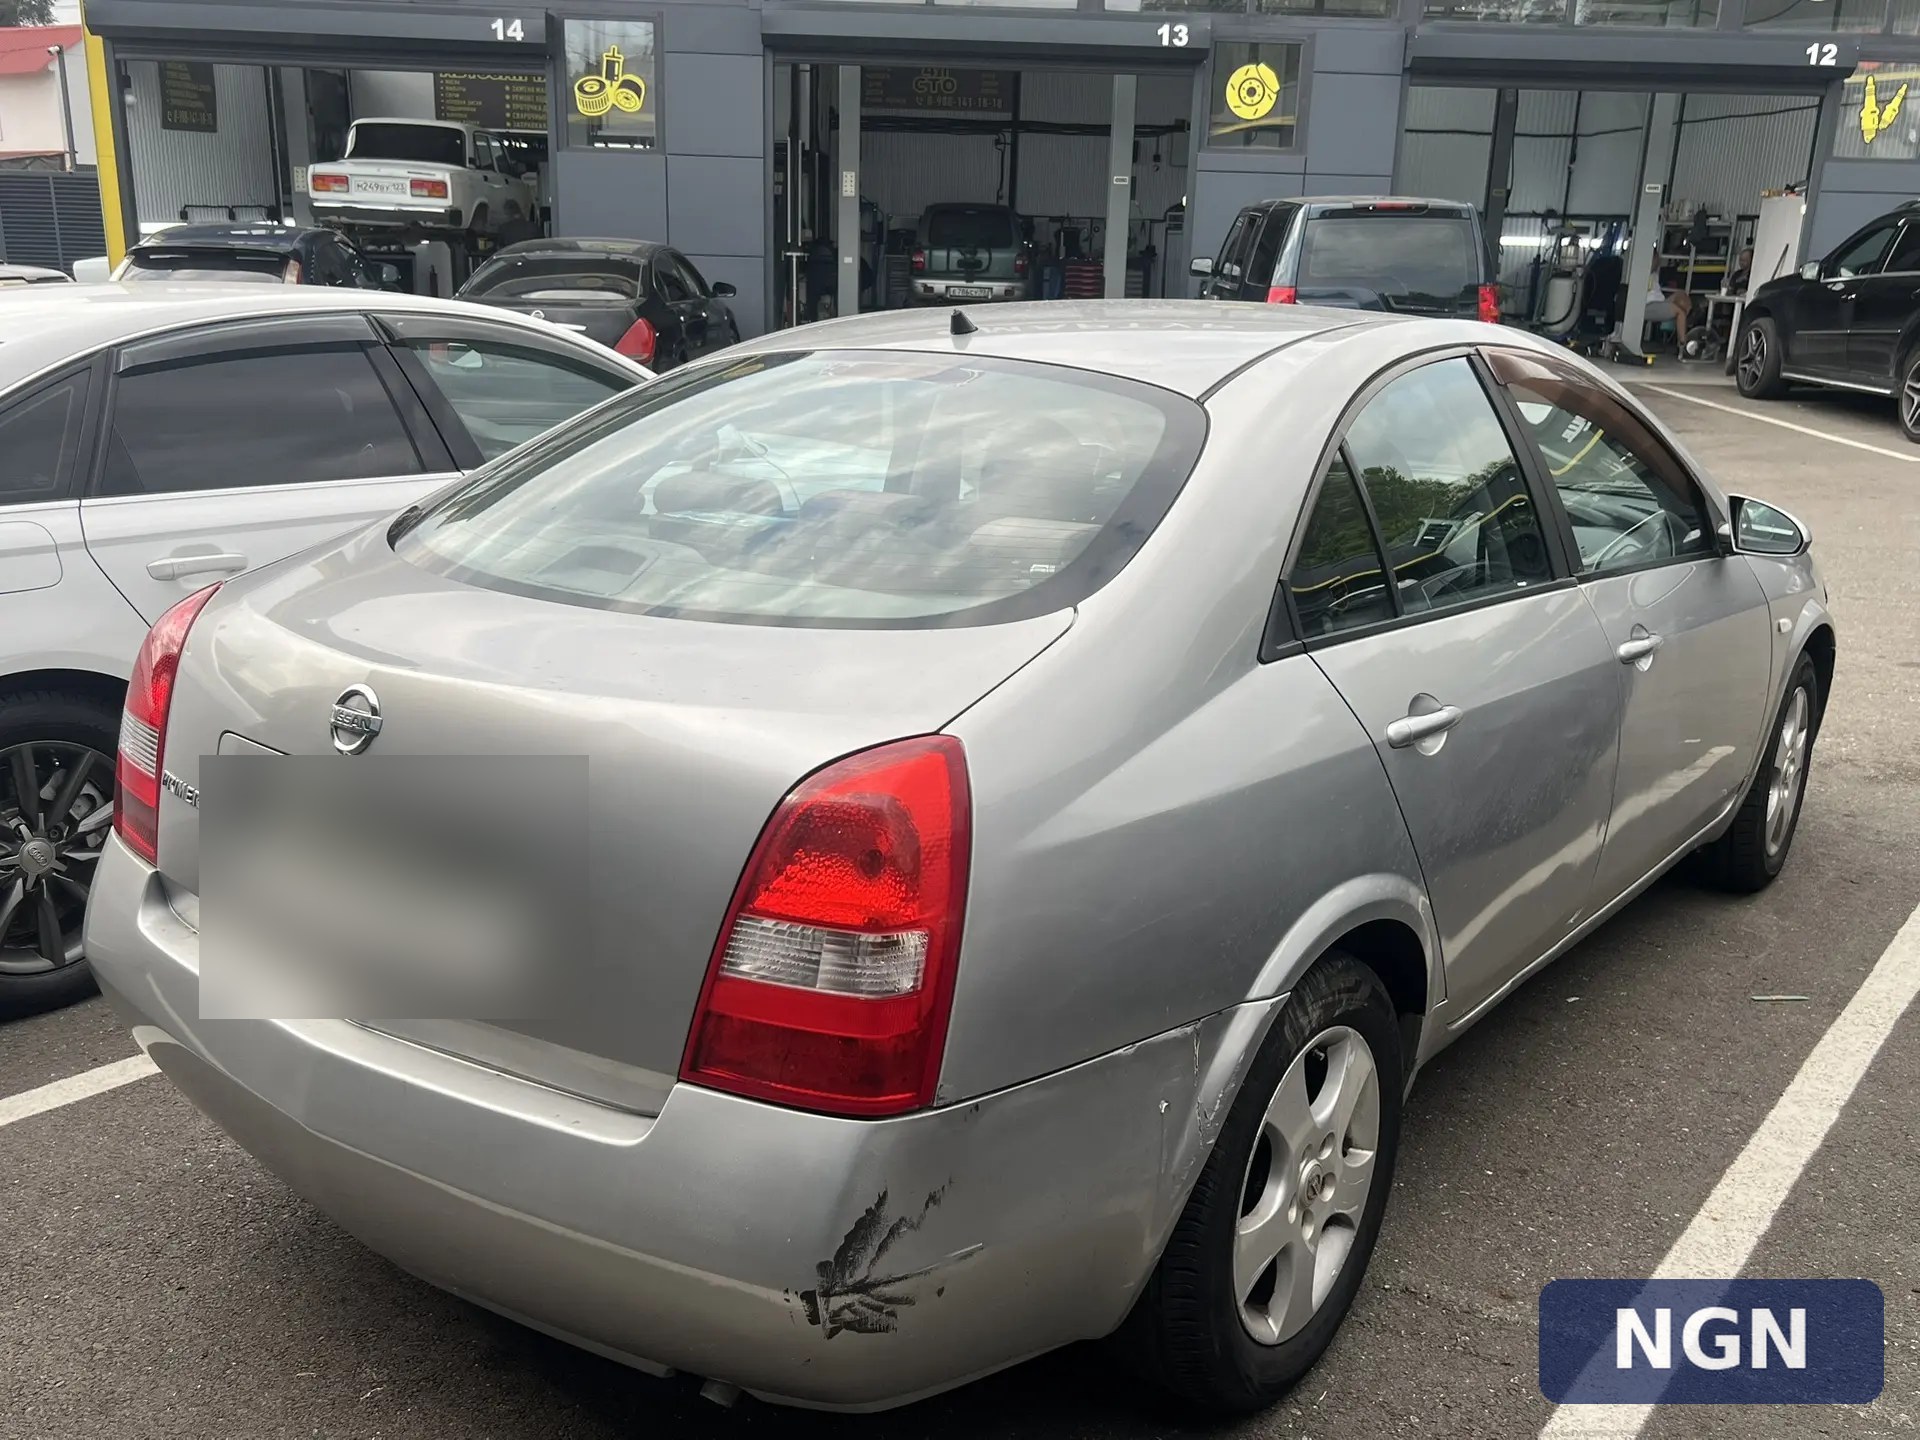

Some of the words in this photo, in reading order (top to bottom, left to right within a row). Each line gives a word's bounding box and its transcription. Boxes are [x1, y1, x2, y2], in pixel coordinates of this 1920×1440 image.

[491, 18, 525, 41] 14
[1157, 23, 1189, 47] 13
[1806, 42, 1838, 66] 12
